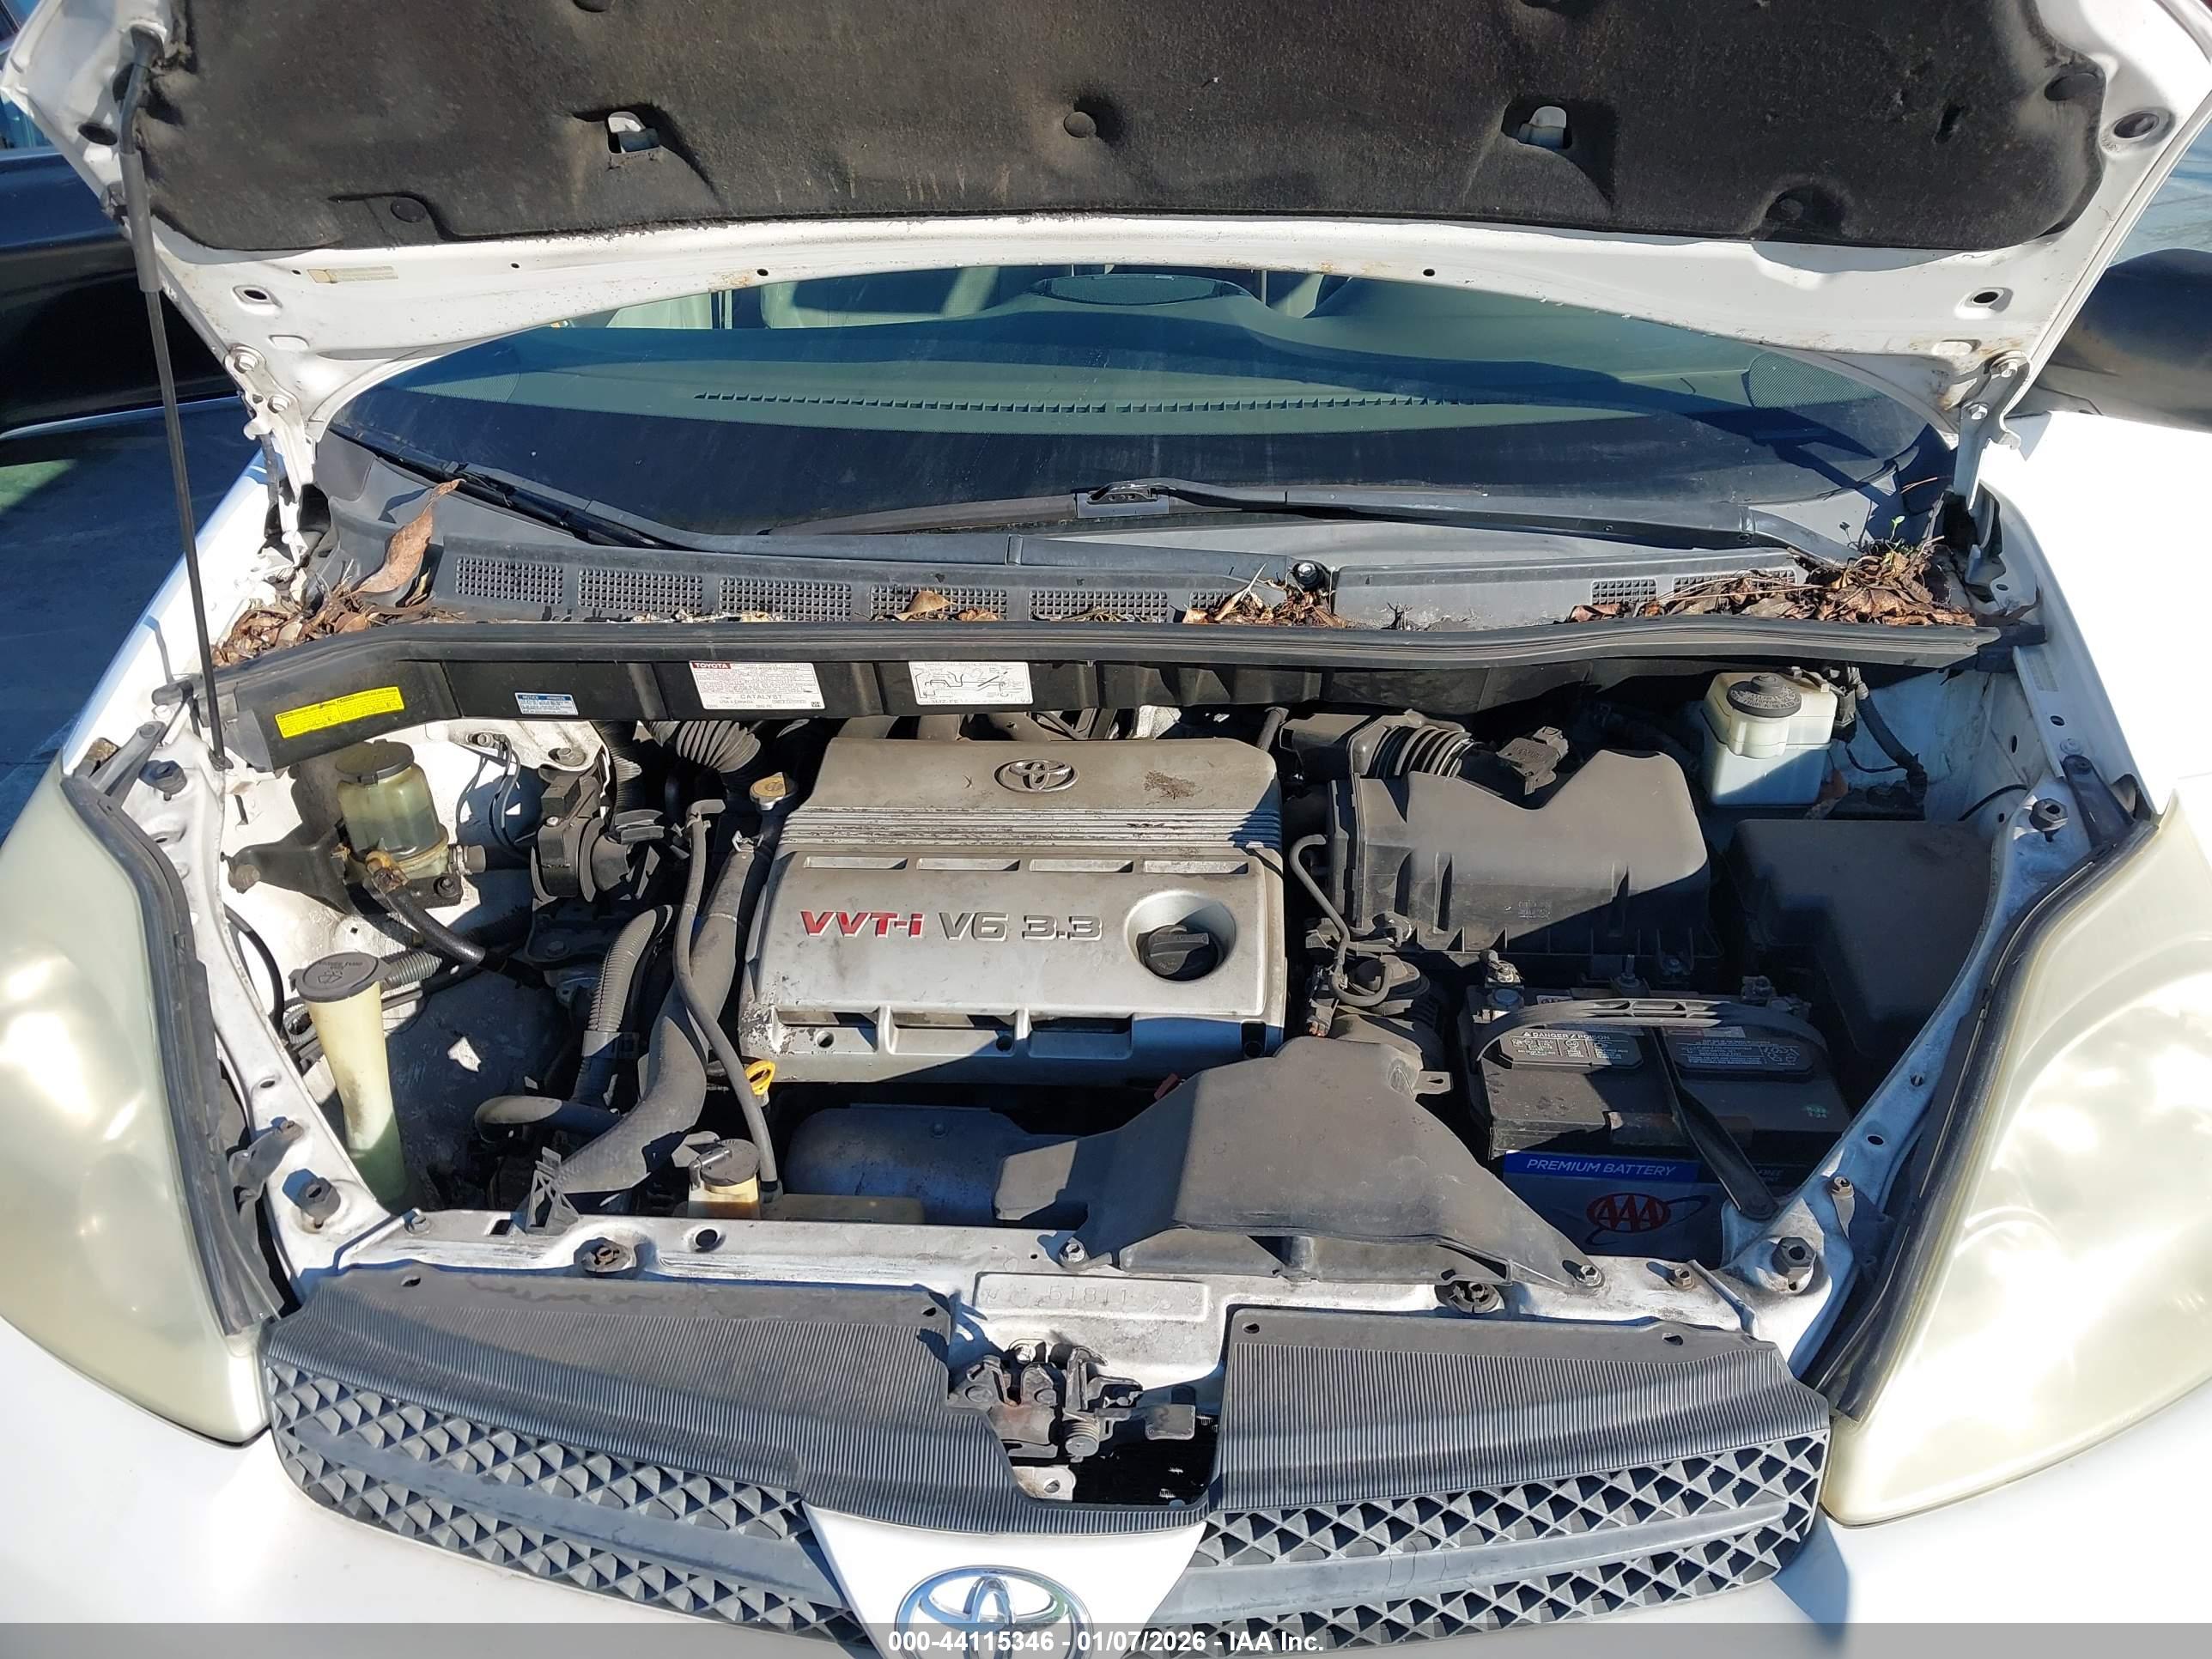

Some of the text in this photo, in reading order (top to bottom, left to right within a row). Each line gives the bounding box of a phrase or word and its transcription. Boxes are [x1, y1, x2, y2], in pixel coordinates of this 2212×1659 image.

[800, 910, 1104, 942] VVT-i V6 3.3
[1526, 1158, 1677, 1176] PREMIUM BATTERY
[1594, 1194, 1664, 1231] AAA
